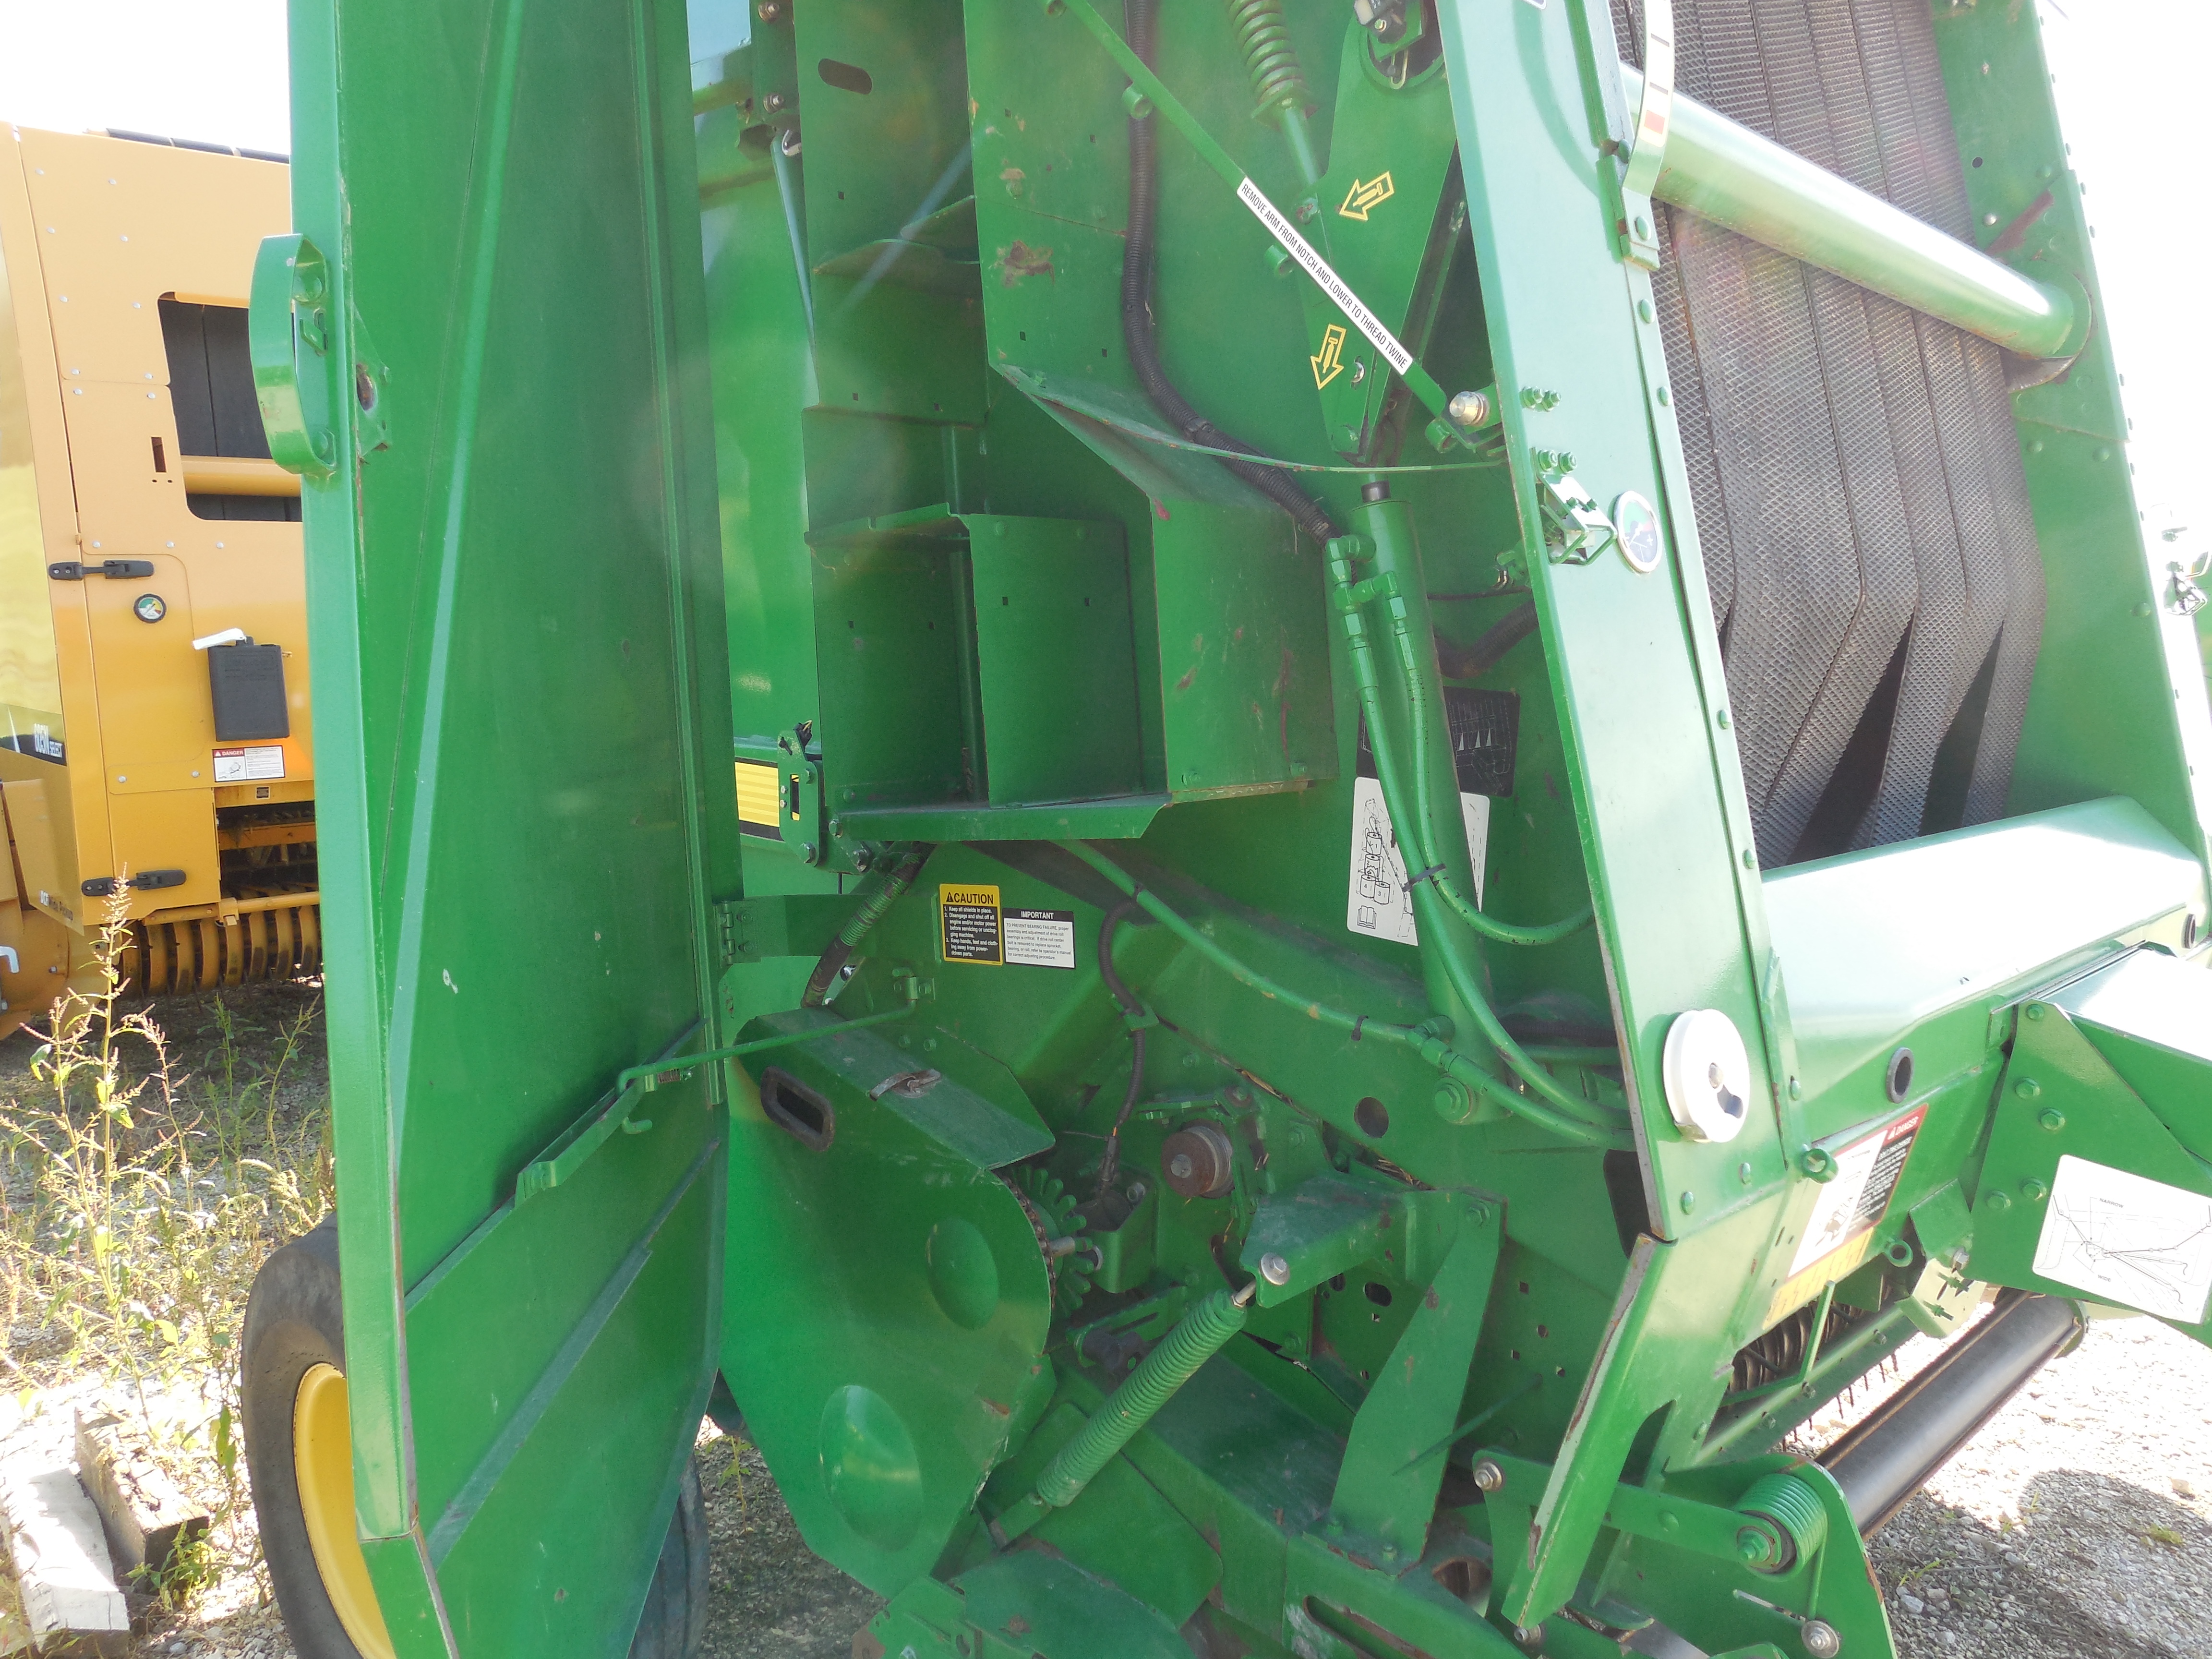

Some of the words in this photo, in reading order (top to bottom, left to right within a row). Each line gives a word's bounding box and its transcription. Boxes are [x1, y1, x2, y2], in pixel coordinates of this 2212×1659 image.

[1241, 184, 1265, 214] REMOVE
[1264, 211, 1279, 229] ARM
[1278, 225, 1298, 248] FROM
[1296, 245, 1317, 270] NOTCH
[1316, 266, 1330, 284] AND
[1329, 280, 1352, 309] LOWER
[1352, 303, 1361, 318] TO
[1360, 313, 1386, 345] THREAD
[1385, 341, 1407, 369] TWINE
[954, 893, 993, 904] CAUTION
[1021, 911, 1054, 919] IMPORTANT
[1895, 1116, 1919, 1136] DANGER
[2100, 1198, 2124, 1208] NARROW
